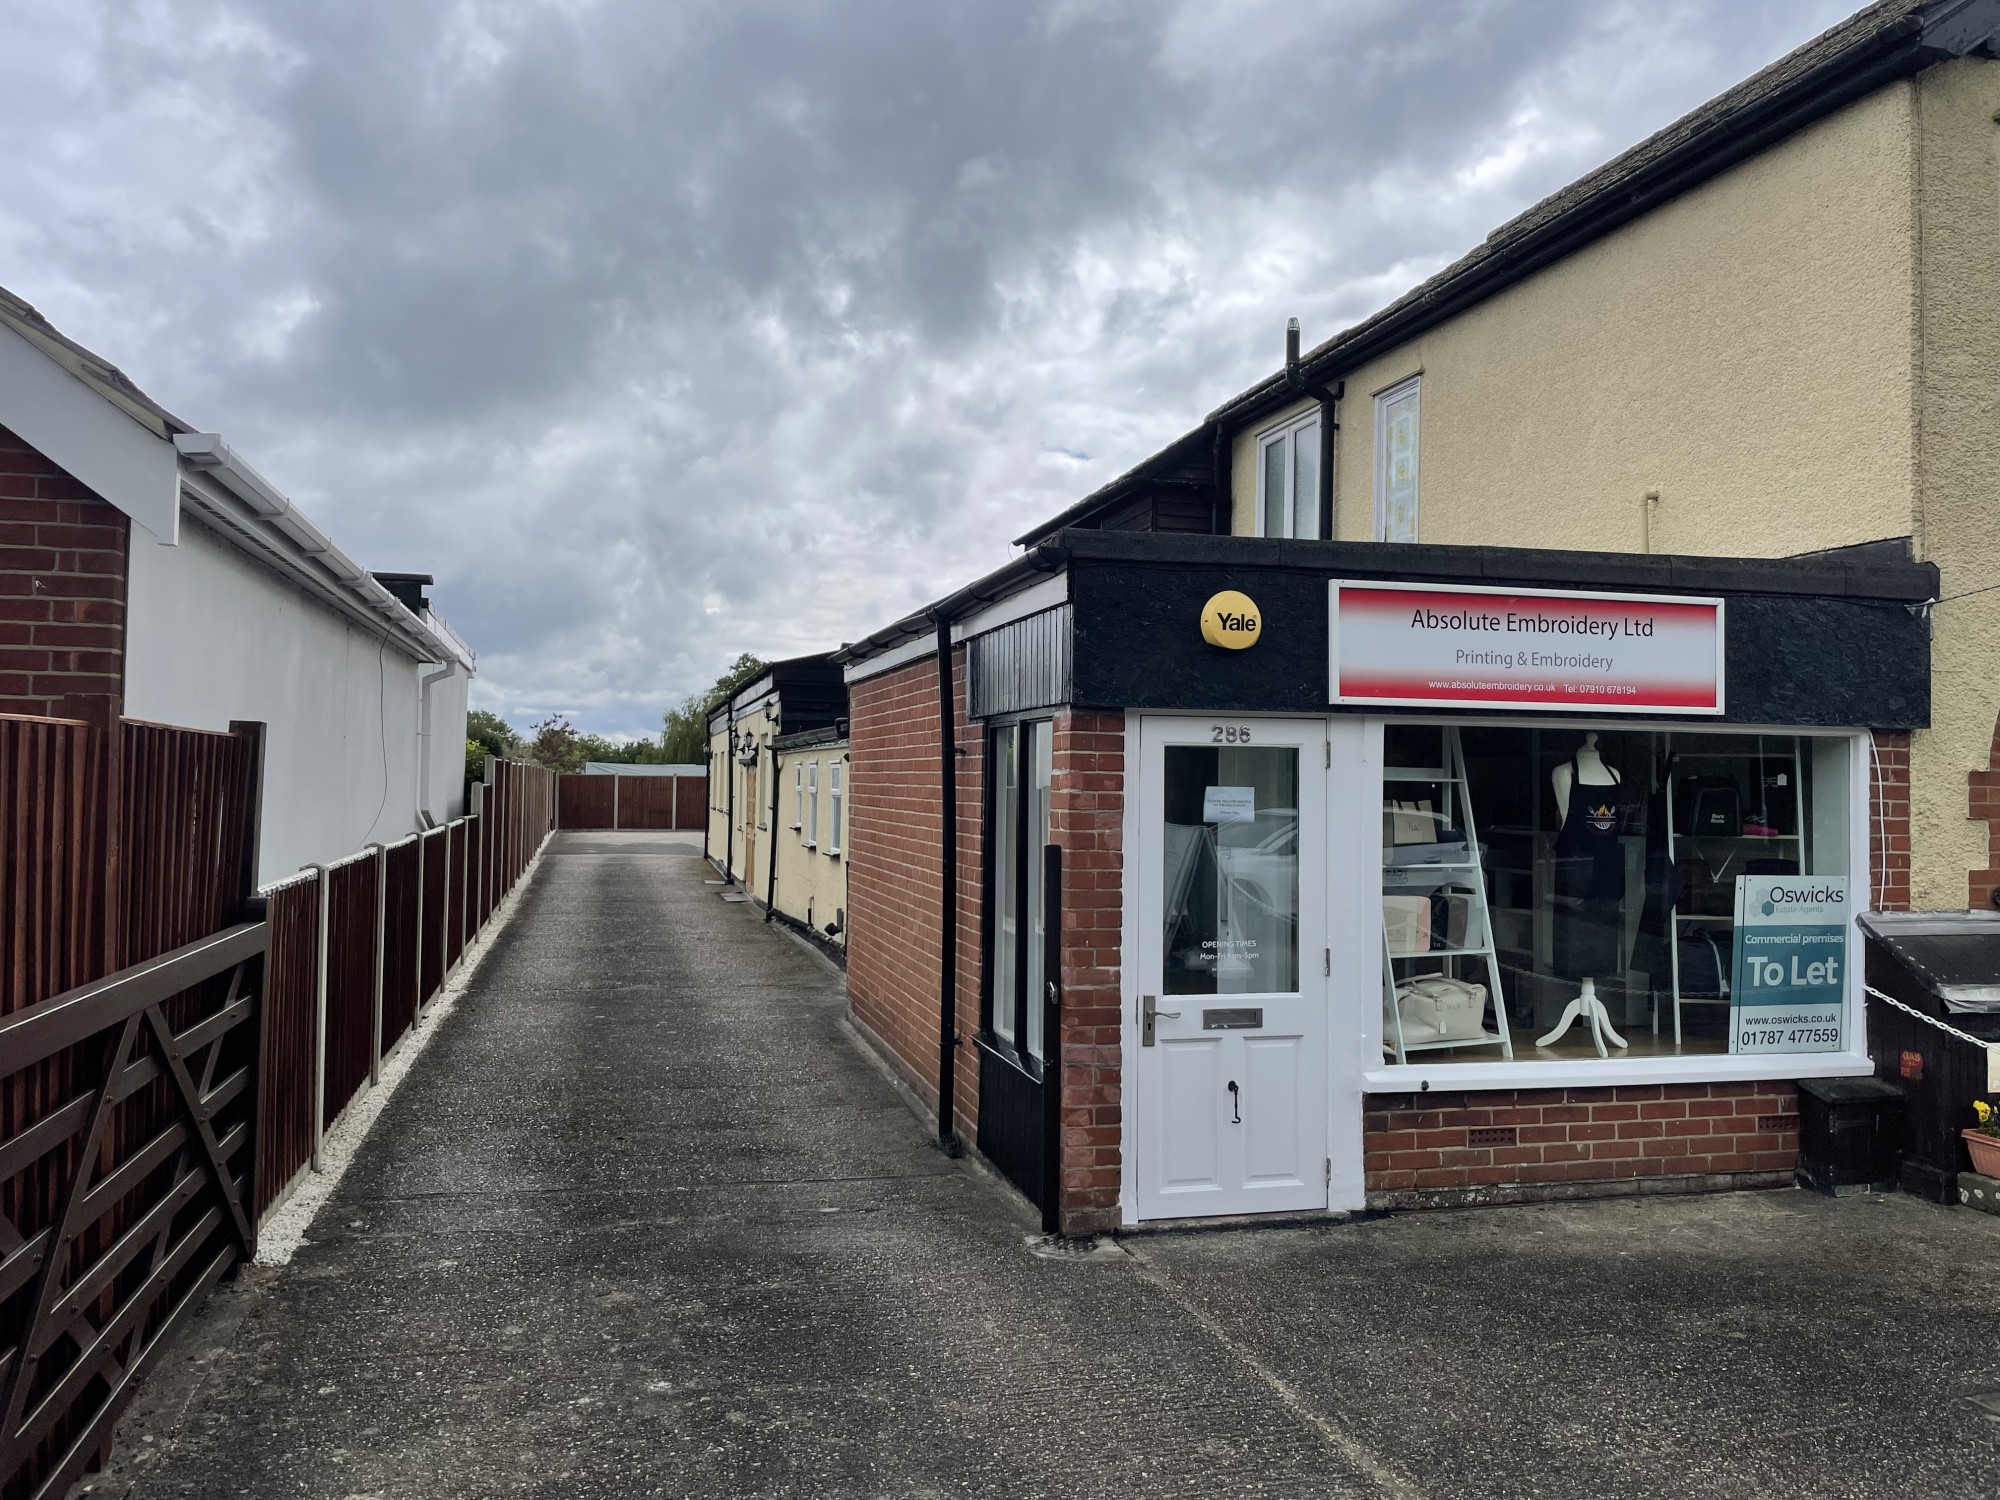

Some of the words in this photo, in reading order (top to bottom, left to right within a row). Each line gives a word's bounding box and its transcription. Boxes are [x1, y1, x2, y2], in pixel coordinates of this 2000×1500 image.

[1217, 612, 1256, 631] Yale
[1411, 609, 1500, 631] Absolute
[1507, 612, 1618, 640] Embroidery
[1624, 617, 1653, 637] Ltd
[1456, 649, 1513, 669] Printing
[1517, 651, 1528, 666] &
[1531, 651, 1613, 672] Embroidery
[1428, 680, 1556, 693] www.absoluteembroidery.co.uk
[1563, 684, 1578, 693] Tel:
[1579, 684, 1605, 694] 07910
[1606, 685, 1636, 695] 678194
[1211, 724, 1251, 743] 286
[1769, 885, 1844, 903] Oswicks
[1775, 905, 1797, 913] Estate
[1799, 905, 1824, 914] Agents
[1202, 940, 1234, 948] OPENING
[1745, 934, 1801, 944] Commercial
[1802, 934, 1844, 945] premises
[1200, 952, 1226, 960] Mon-Fri
[1747, 956, 1784, 987] To
[1791, 955, 1838, 986] Let
[1745, 1013, 1837, 1026] www.oswicks.co.uk
[1741, 1030, 1784, 1046] 01787
[1788, 1028, 1839, 1044] 477559
[1903, 1051, 1921, 1062] GAS
